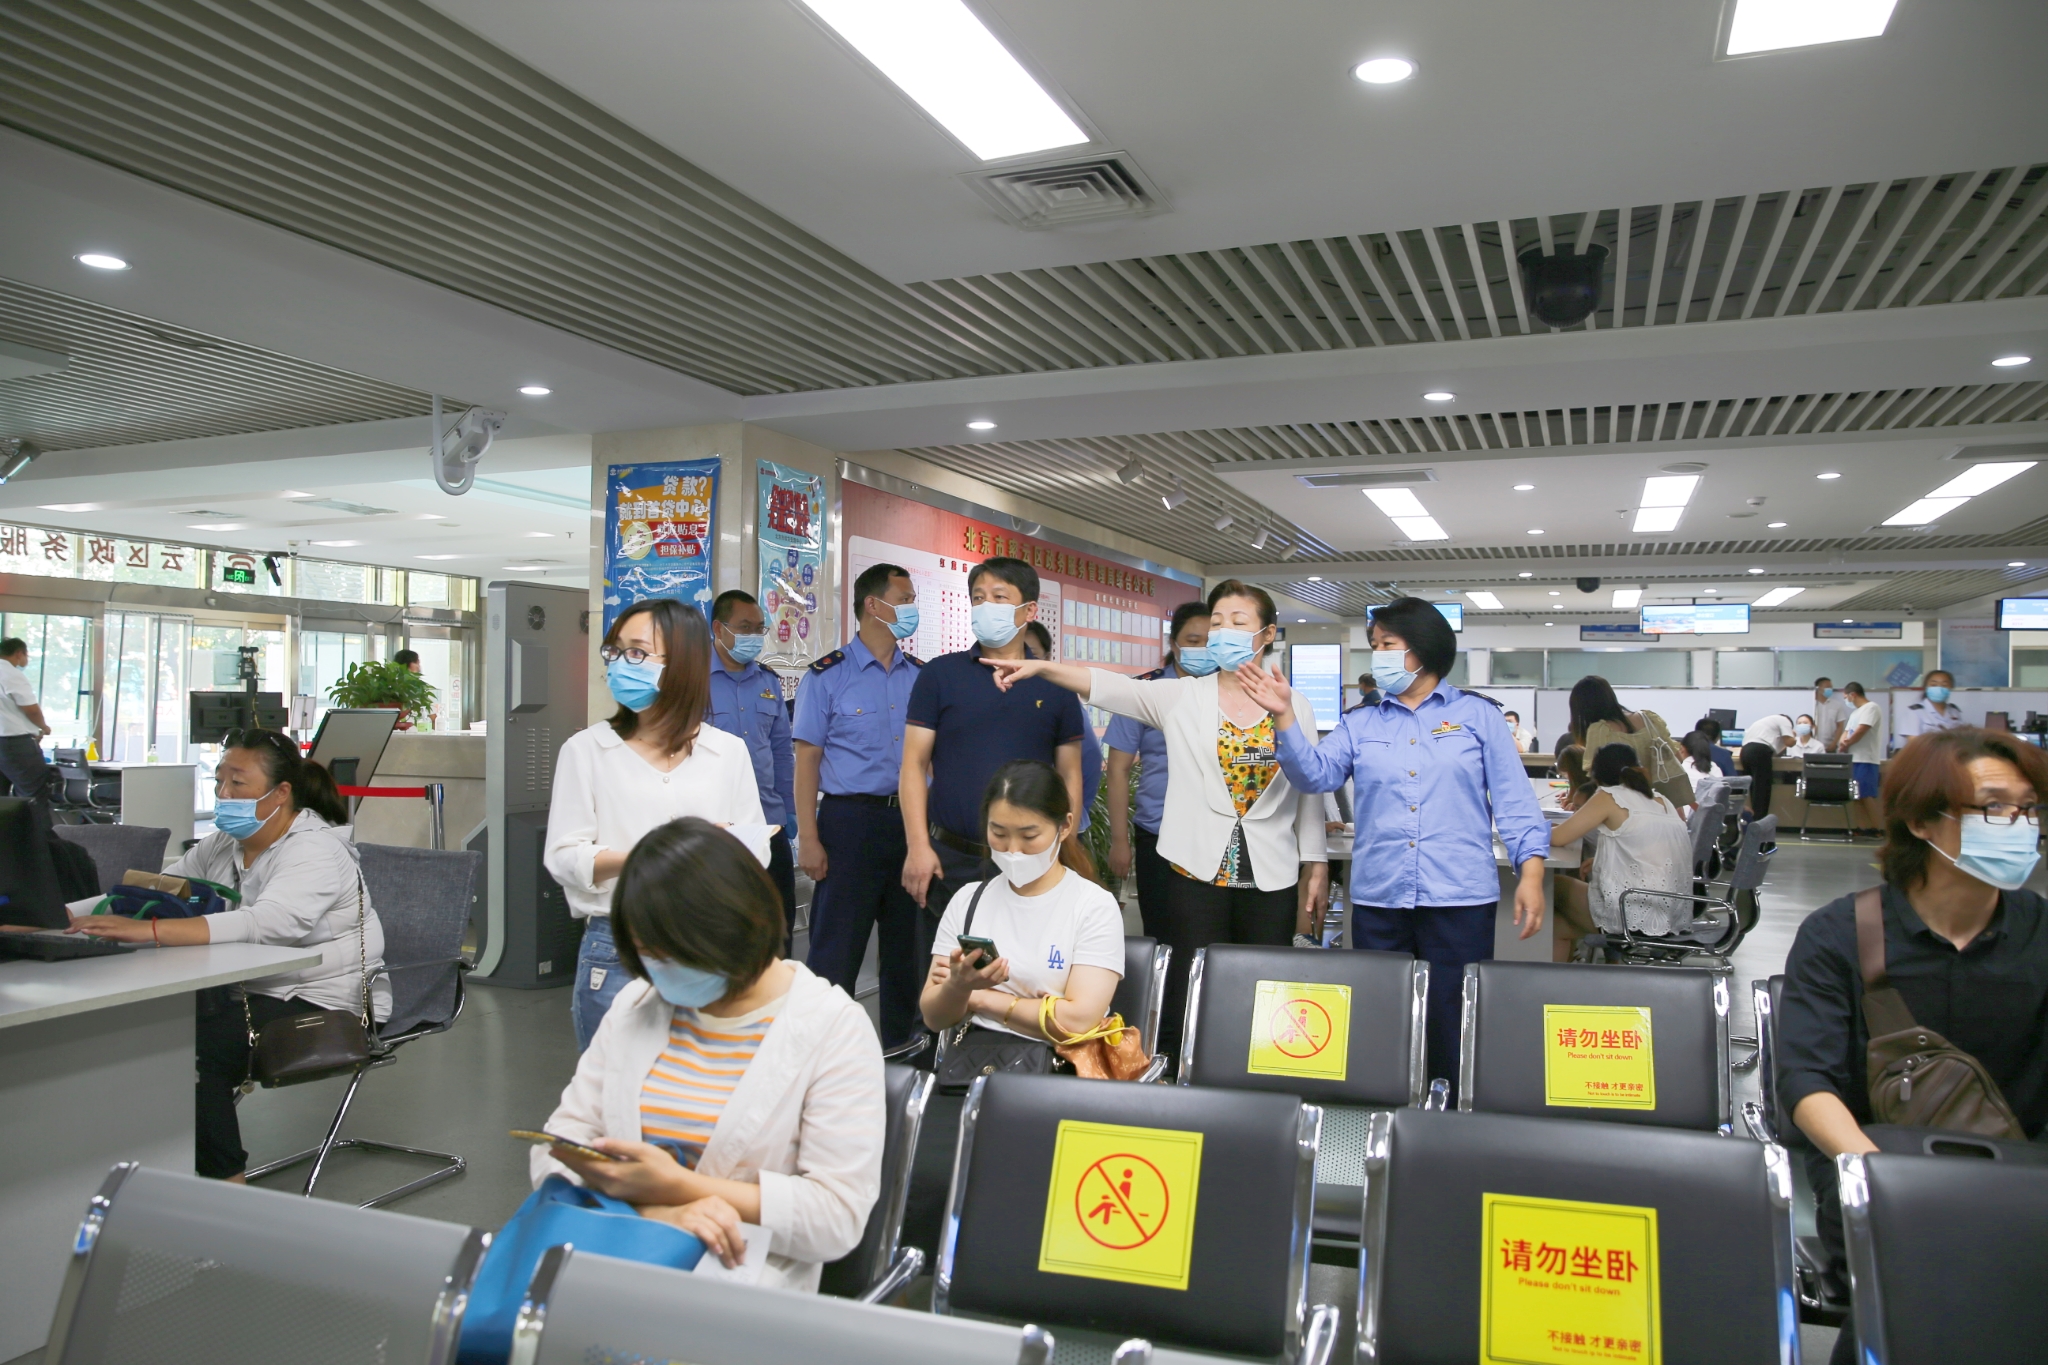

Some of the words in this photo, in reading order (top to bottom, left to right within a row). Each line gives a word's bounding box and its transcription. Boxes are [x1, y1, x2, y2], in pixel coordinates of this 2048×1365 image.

[662, 475, 708, 497] 贷款?
[1047, 944, 1065, 970] LA
[1557, 1028, 1643, 1050] 请勿坐卧
[1567, 1051, 1588, 1060] Please
[1589, 1052, 1605, 1060] don't
[1605, 1052, 1614, 1060] sit
[1614, 1053, 1633, 1061] down
[1585, 1082, 1609, 1090] 不接触
[1611, 1083, 1644, 1092] 才更亲密
[1500, 1238, 1639, 1283] 请勿坐卧
[1518, 1276, 1550, 1289] Please
[1552, 1280, 1578, 1292] don't
[1579, 1282, 1592, 1294] sit
[1594, 1285, 1621, 1296] down
[1547, 1329, 1586, 1346] 不接触
[1589, 1336, 1642, 1353] 才更亲密
